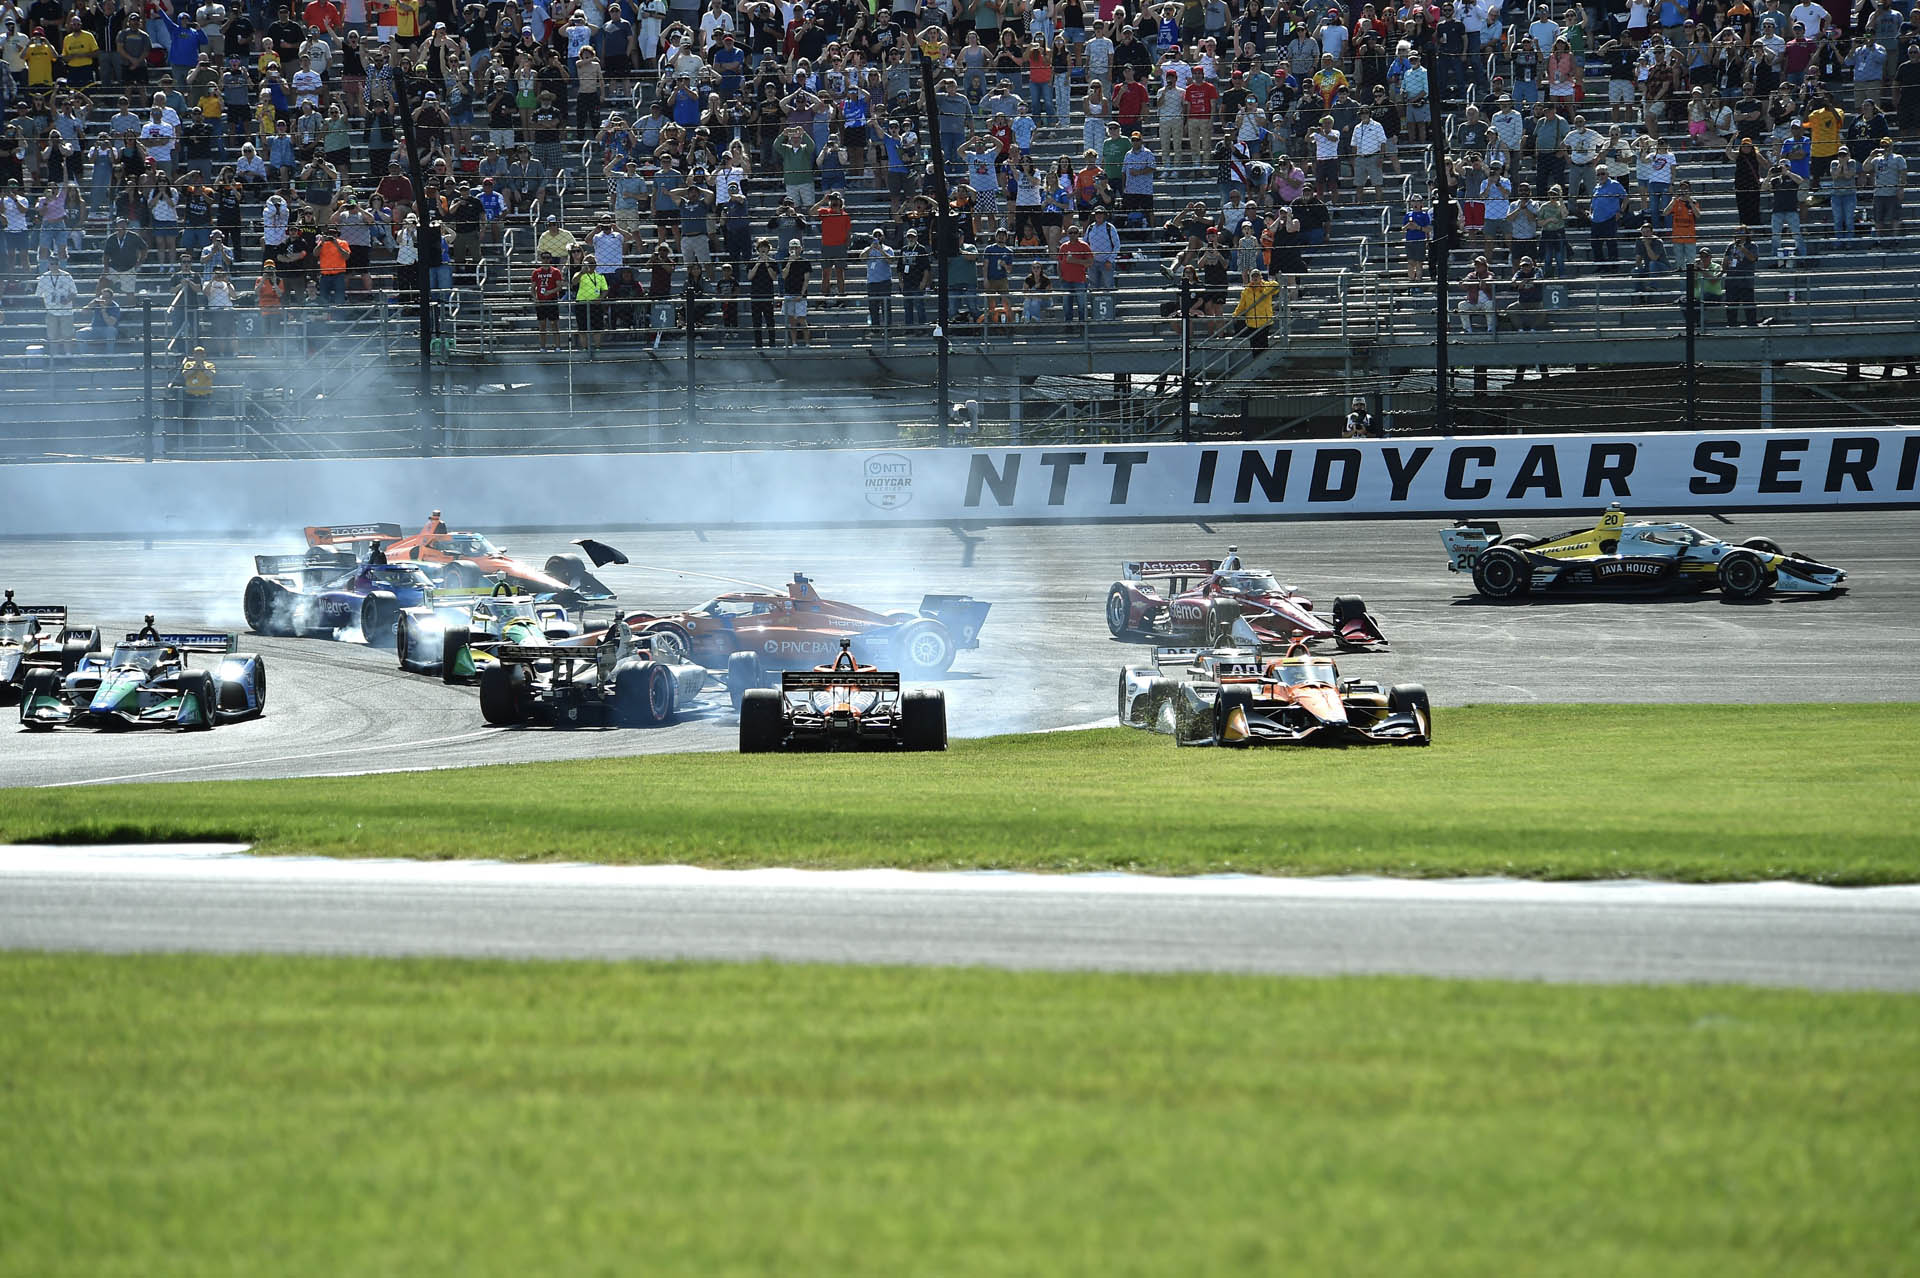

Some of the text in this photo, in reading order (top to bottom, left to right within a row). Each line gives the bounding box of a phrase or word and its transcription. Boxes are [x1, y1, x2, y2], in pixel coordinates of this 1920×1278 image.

[1551, 290, 1560, 304] 6
[1099, 302, 1107, 315] 5
[660, 310, 667, 323] 4
[245, 318, 254, 331] 3
[883, 463, 907, 473] NTT
[963, 436, 1920, 507] NTT INDYCAR SERI
[864, 478, 912, 487] INDYCAR
[1604, 514, 1618, 526] 20
[1457, 553, 1477, 569] 20
[1600, 562, 1661, 576] JAVA HOUSE
[318, 598, 351, 616] Allegra
[1170, 601, 1202, 620] stemo
[781, 641, 843, 653] PNC BAN
